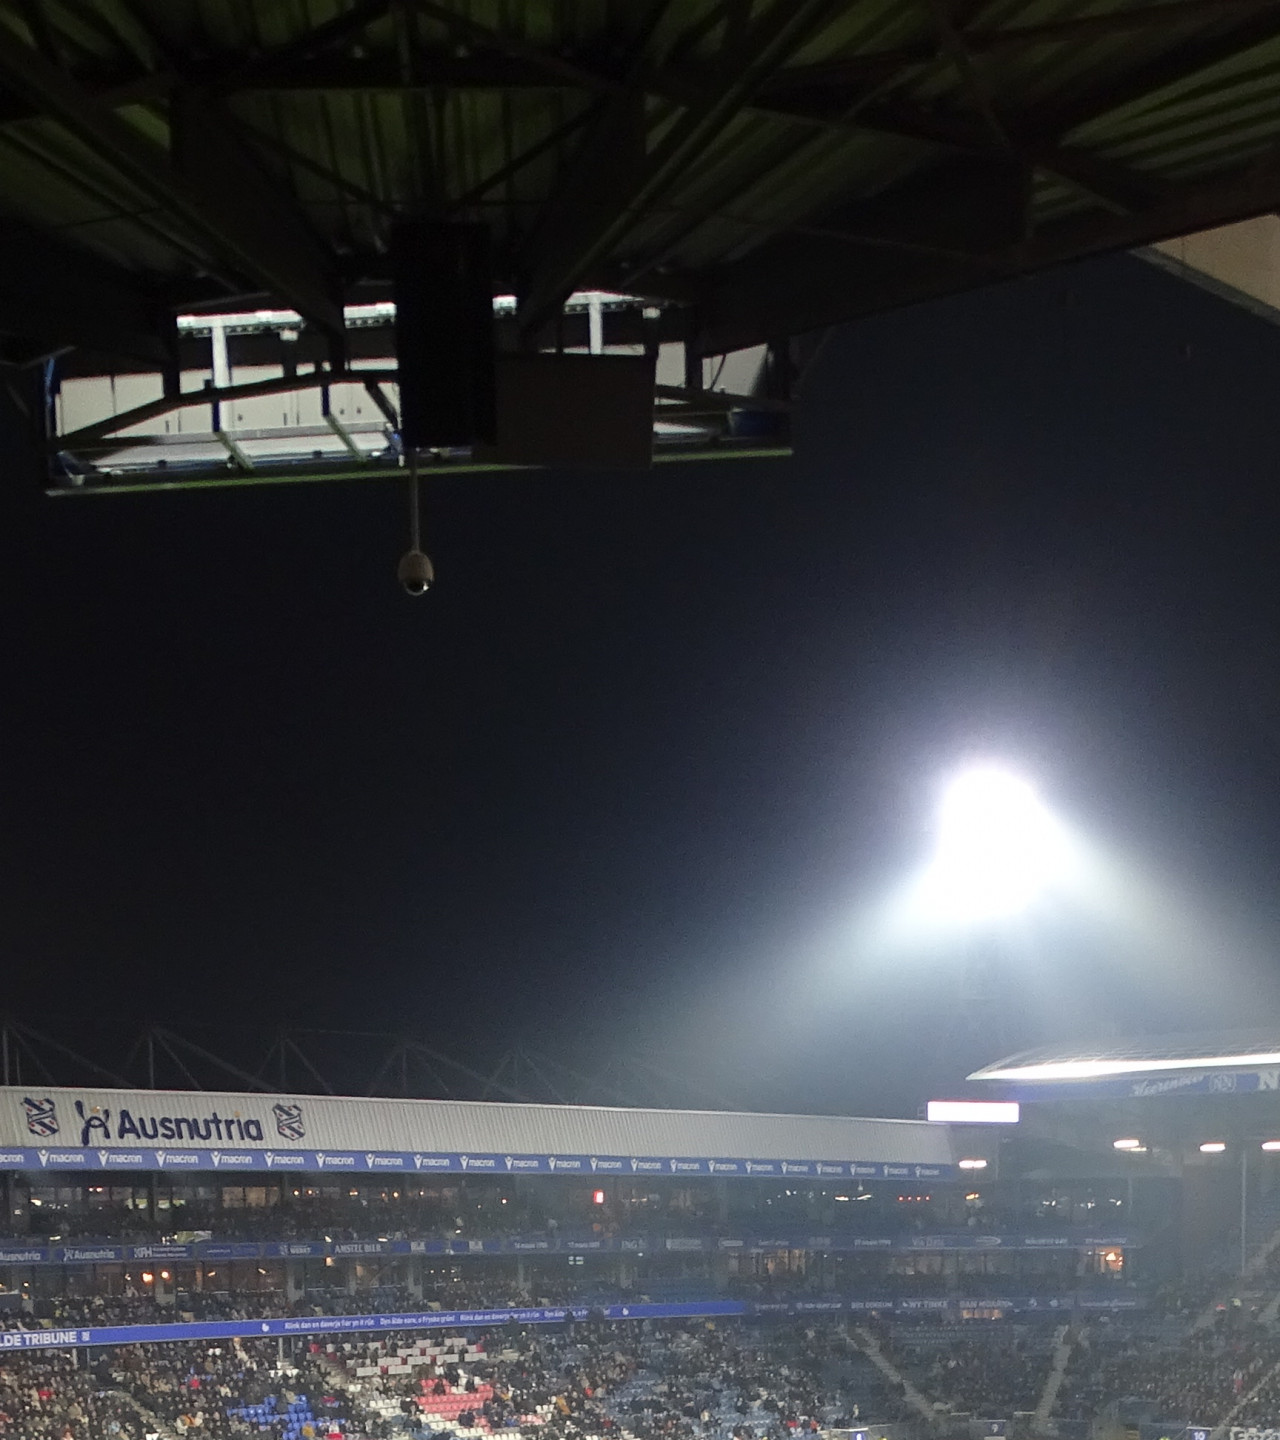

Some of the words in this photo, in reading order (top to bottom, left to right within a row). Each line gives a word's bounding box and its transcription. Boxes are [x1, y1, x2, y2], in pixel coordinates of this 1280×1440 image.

[119, 1108, 264, 1141] Ausnutria
[49, 1152, 85, 1164] macron
[107, 1153, 143, 1164] macron
[166, 1153, 199, 1164] macron
[220, 1153, 253, 1165] macron
[273, 1154, 305, 1165] macron
[324, 1155, 355, 1166] macron
[373, 1155, 403, 1166] macron
[422, 1156, 450, 1168] macron
[468, 1157, 495, 1168] macron
[24, 1331, 77, 1345] TRIBUNE
